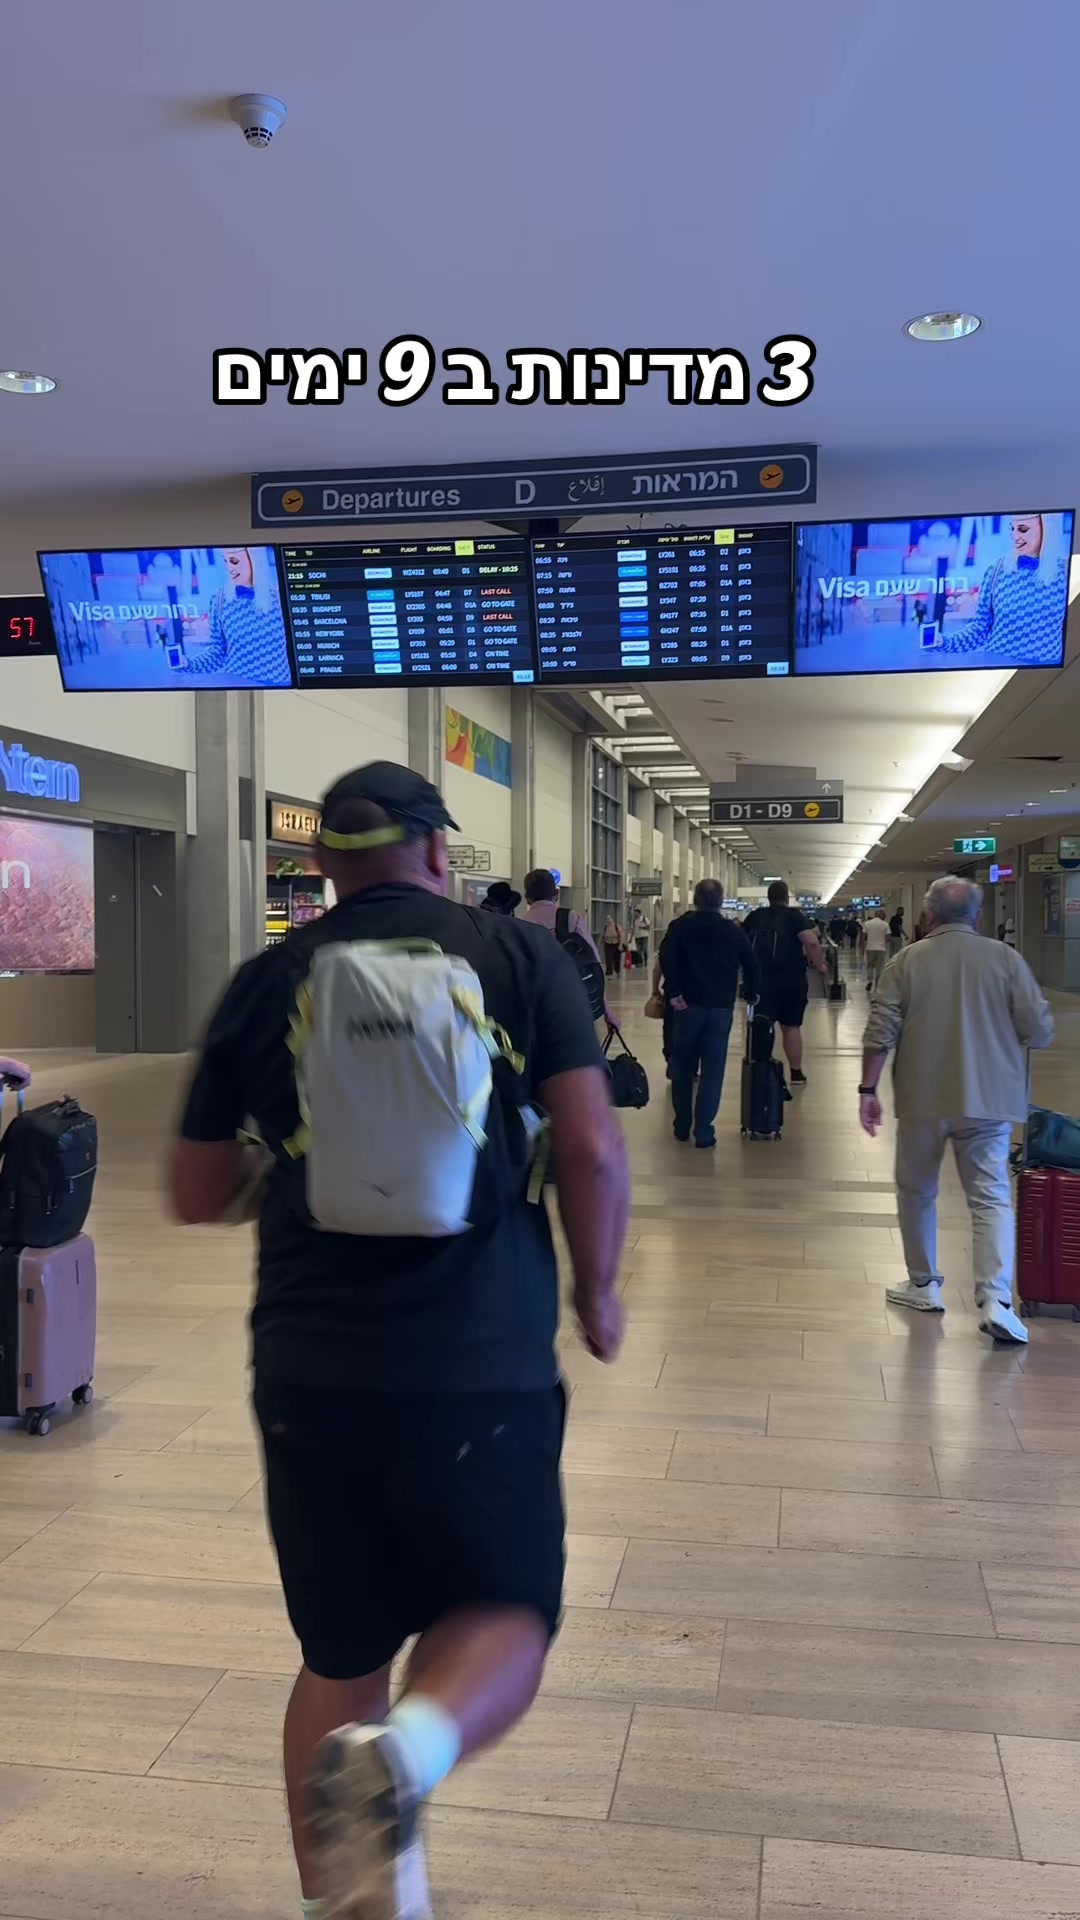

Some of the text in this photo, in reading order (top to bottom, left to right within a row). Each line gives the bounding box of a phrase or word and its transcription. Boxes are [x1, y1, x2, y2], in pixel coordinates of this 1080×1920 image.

[515, 479, 536, 505] D
[567, 474, 606, 502] إقلاع
[631, 469, 738, 495] המראות
[322, 487, 461, 515] Departures
[818, 575, 969, 599] ברור שעם Visa
[68, 601, 200, 622] ברור שעם Visa
[730, 804, 751, 819] D1
[768, 803, 792, 818] D9
